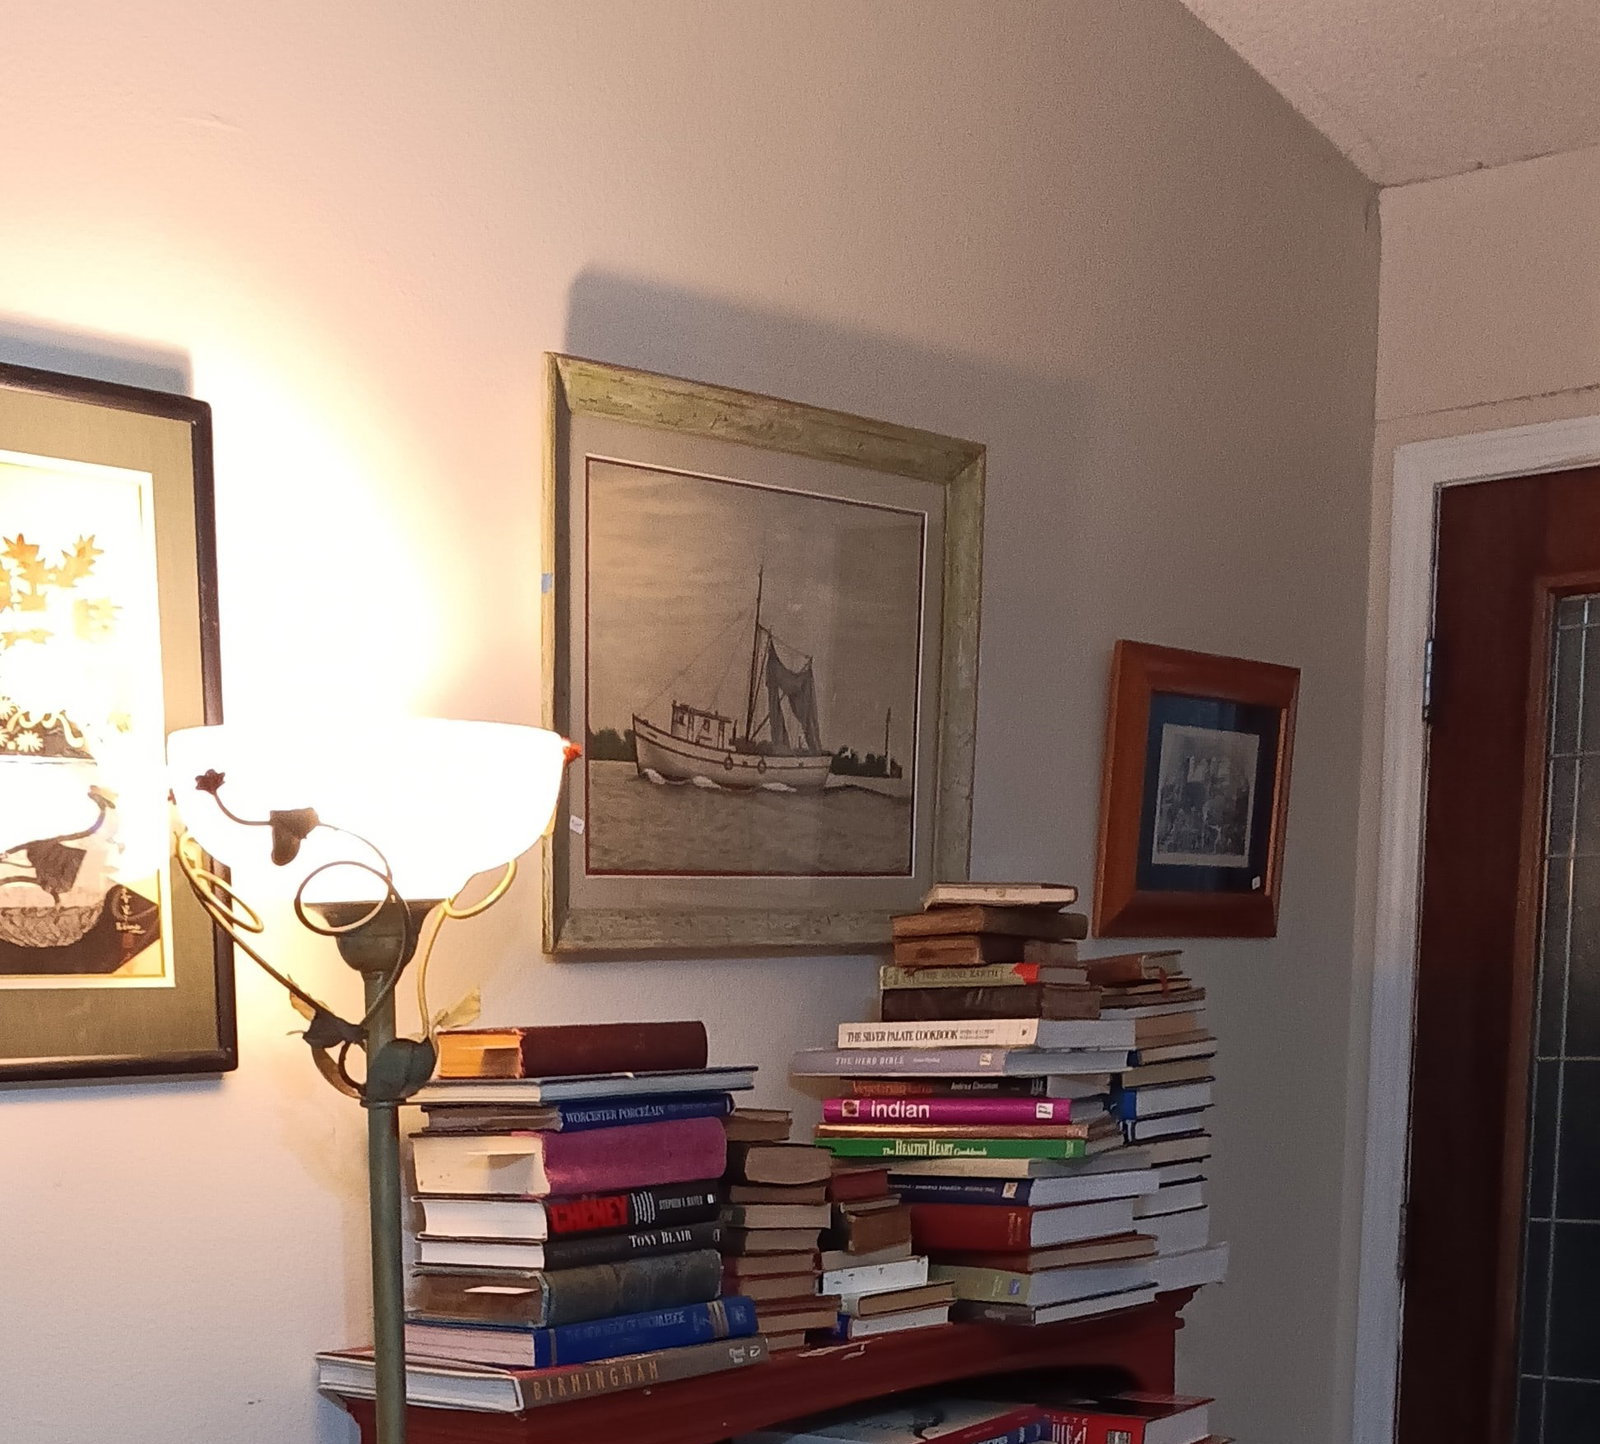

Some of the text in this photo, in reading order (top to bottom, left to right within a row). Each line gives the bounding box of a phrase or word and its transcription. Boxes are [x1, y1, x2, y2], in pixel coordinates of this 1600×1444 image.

[847, 1031, 862, 1043] THE
[862, 1031, 886, 1043] SILVER
[887, 1030, 914, 1042] PALATE
[915, 1029, 958, 1041] COOKBOOK
[835, 1056, 853, 1066] THE
[566, 1109, 617, 1124] WORCESTER
[618, 1104, 665, 1121] PORCELAIN
[871, 1100, 930, 1118] indian
[882, 1140, 987, 1156] The HEALTHY HEART Cookbook
[551, 1195, 628, 1233] CHENEY
[628, 1229, 692, 1249] TONY BLAIR
[533, 1361, 660, 1401] BIRMINGHAM
